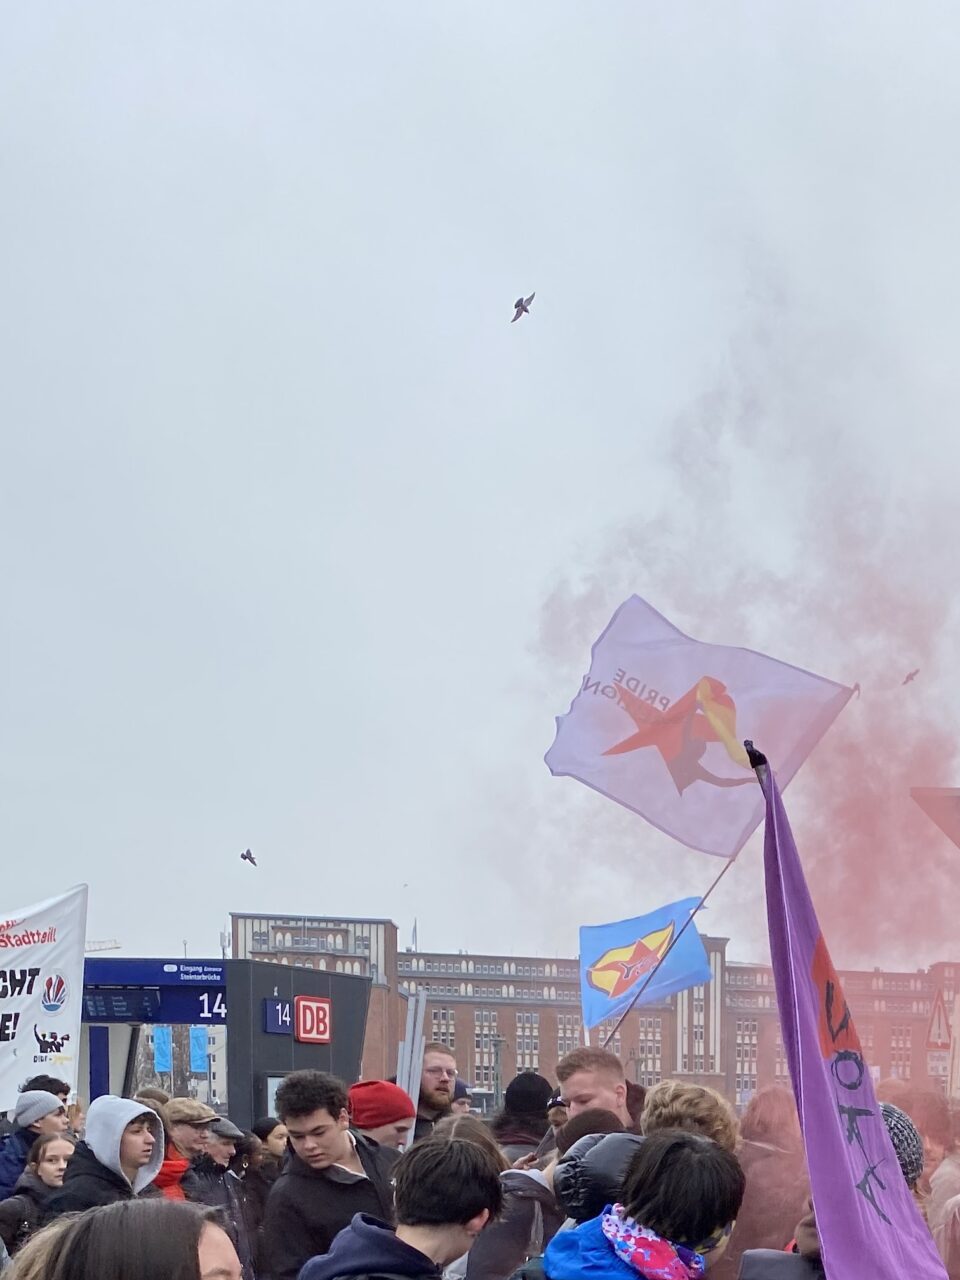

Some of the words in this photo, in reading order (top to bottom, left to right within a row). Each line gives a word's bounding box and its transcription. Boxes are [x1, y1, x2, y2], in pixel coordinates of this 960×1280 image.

[199, 992, 227, 1018] 14
[275, 1002, 291, 1026] 14
[302, 1004, 328, 1035] DB
